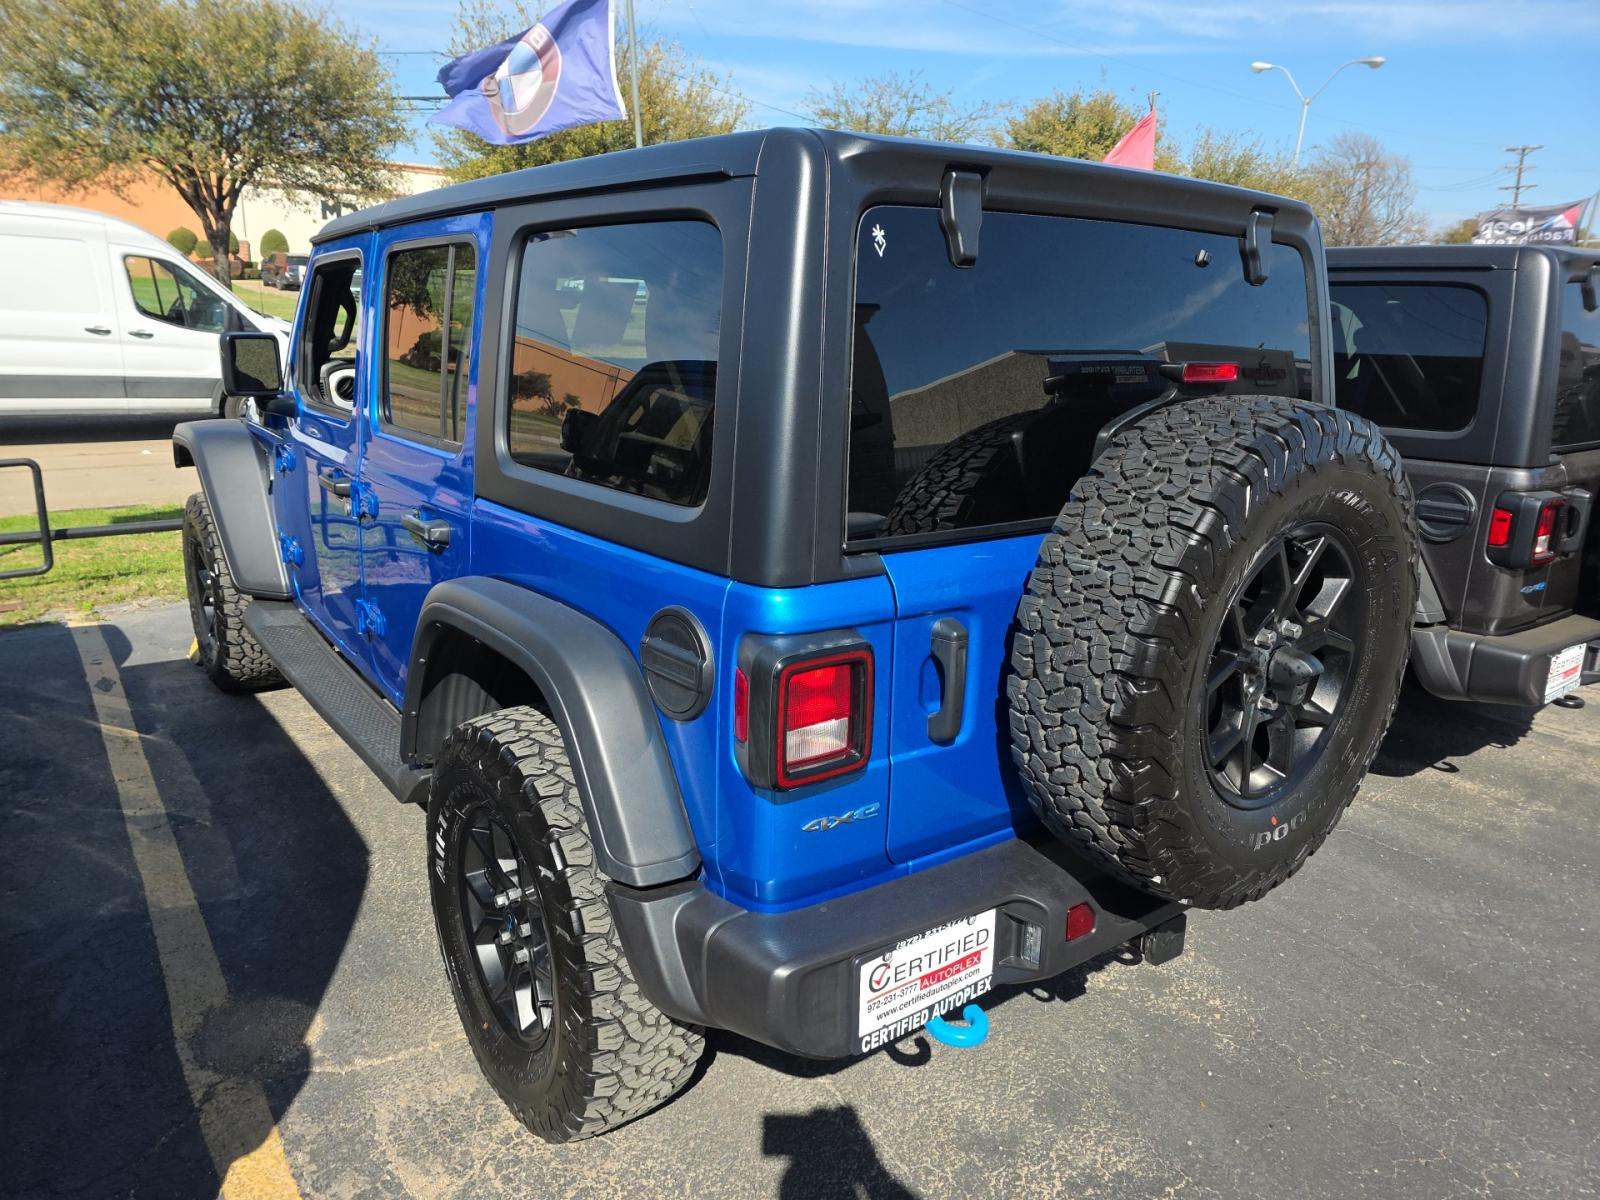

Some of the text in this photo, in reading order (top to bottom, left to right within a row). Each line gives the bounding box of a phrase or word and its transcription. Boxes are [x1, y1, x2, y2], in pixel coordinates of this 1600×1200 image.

[867, 955, 981, 1013] 972-231-3777 AUTOPLEX
[868, 928, 989, 993] CERTIFIED
[861, 976, 992, 1053] CERTIFIED AUTOPLEX
[876, 968, 980, 1021] www.certifiedautoplex.com
